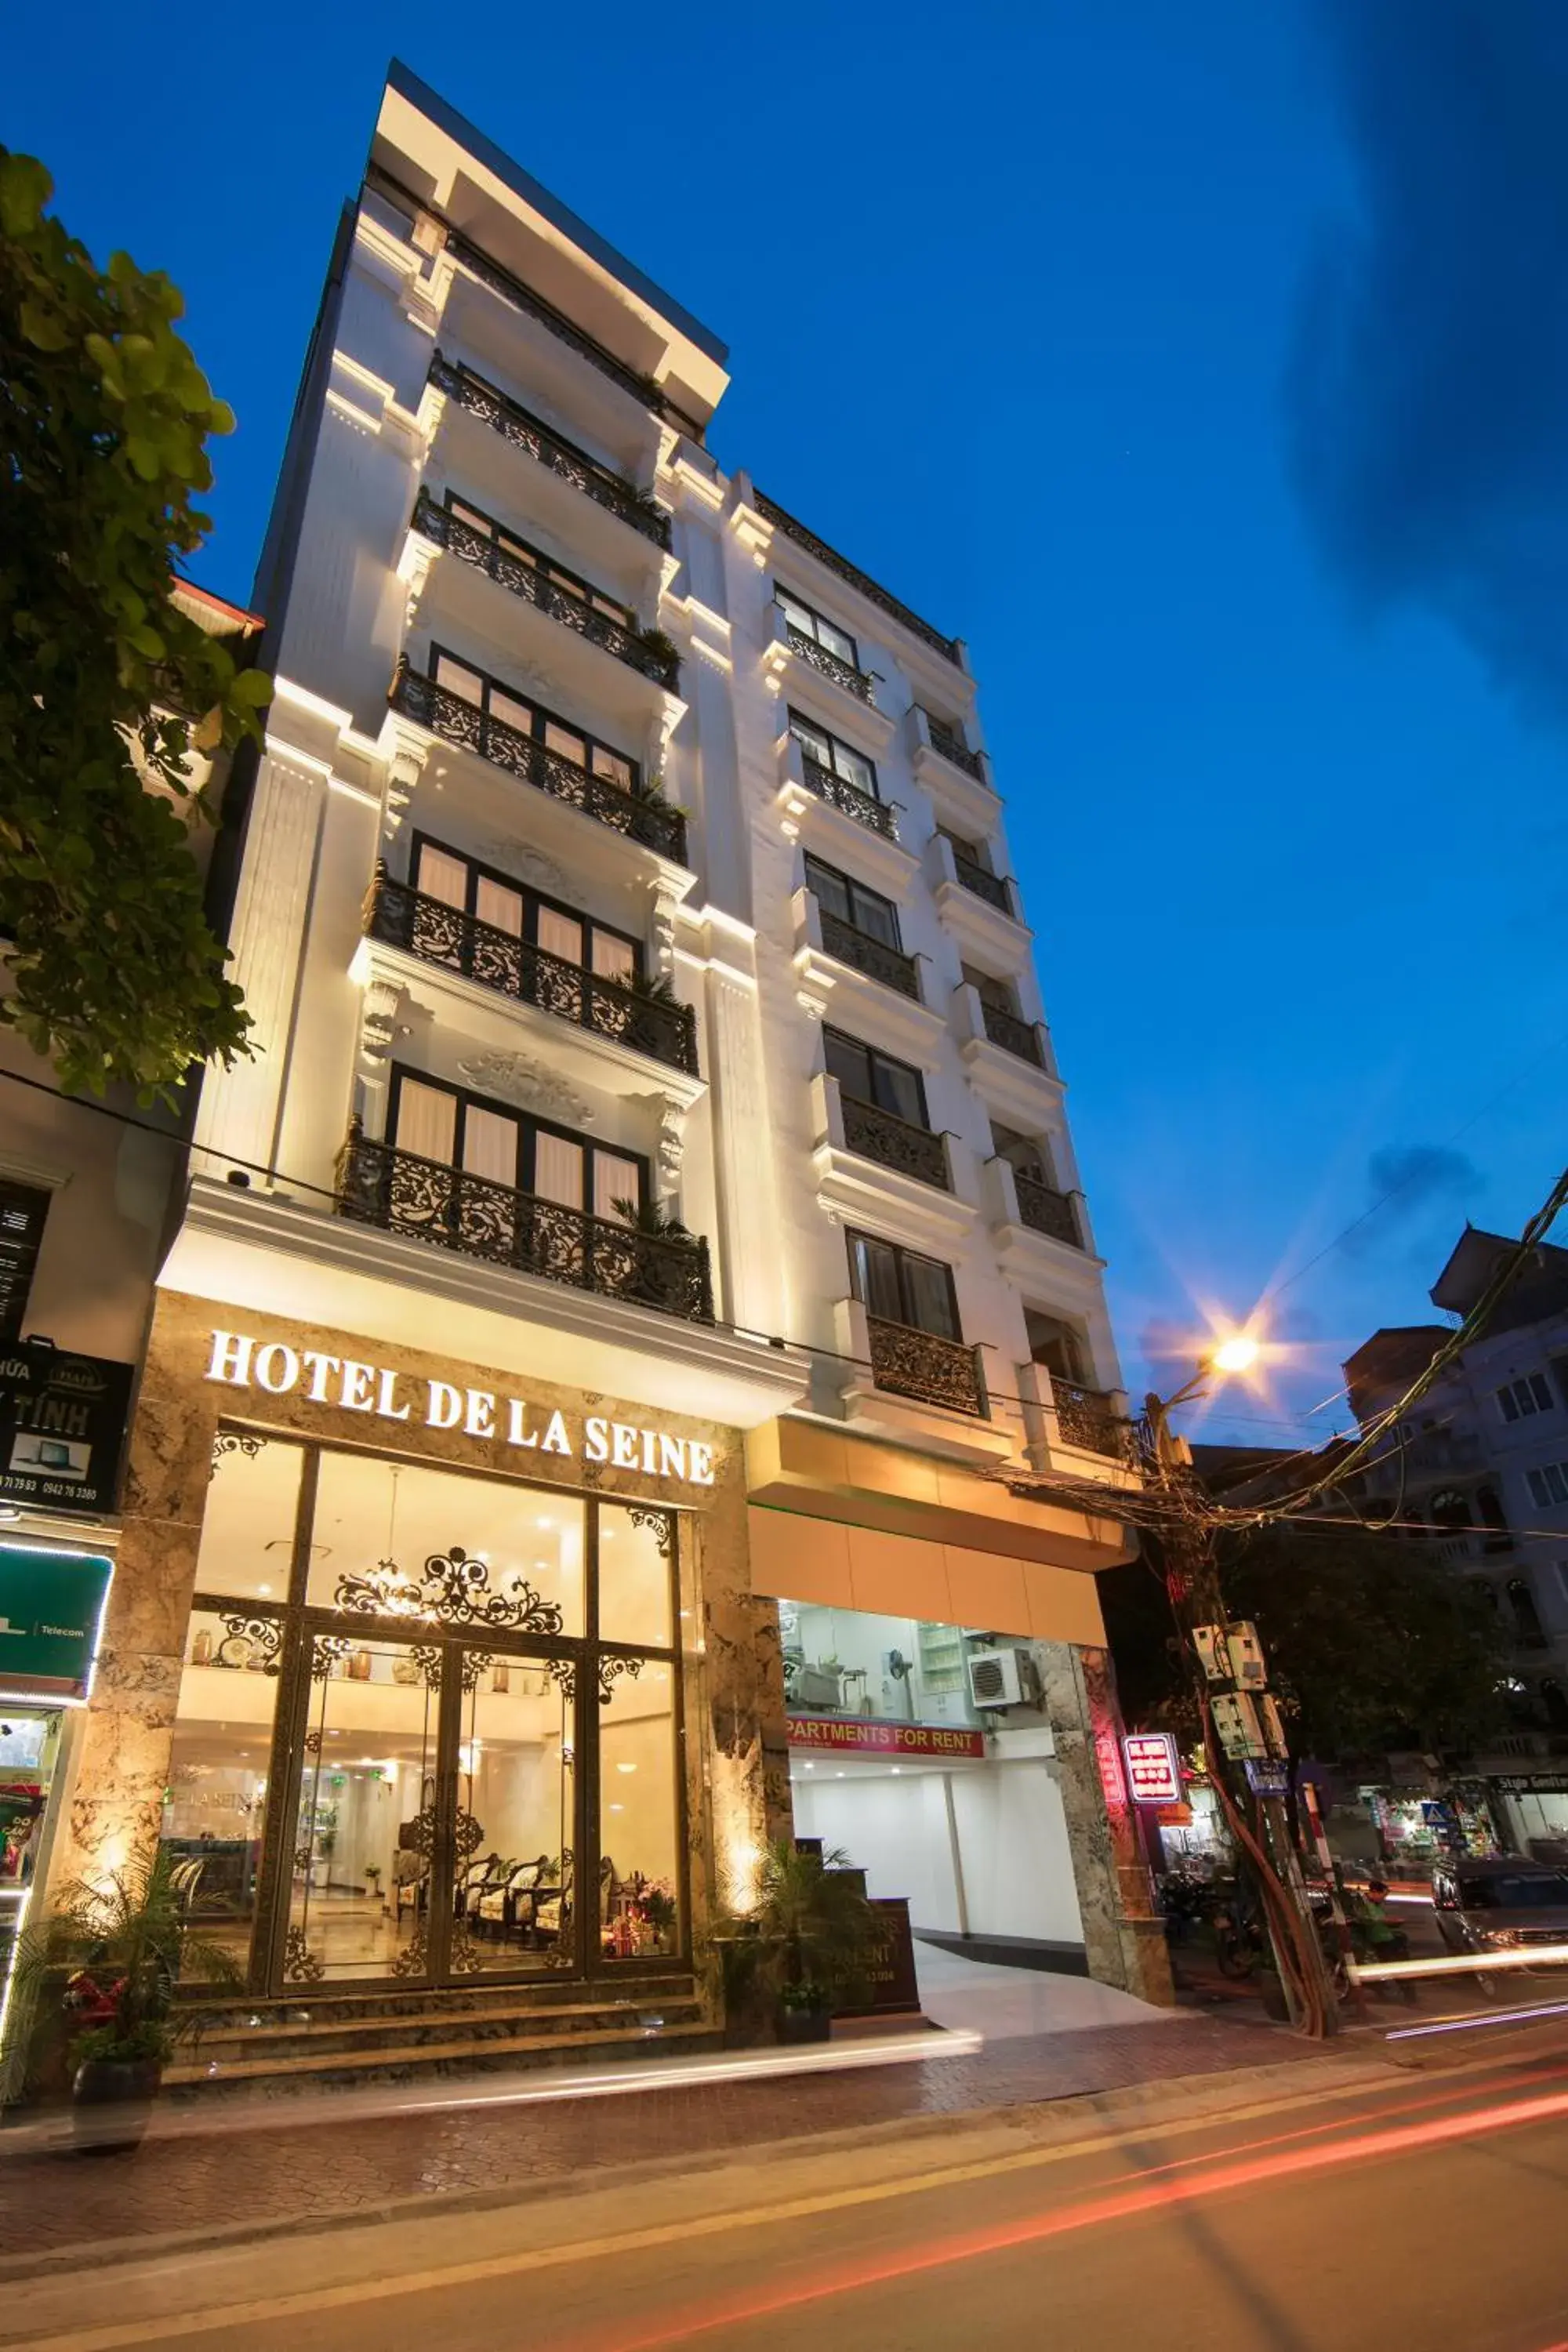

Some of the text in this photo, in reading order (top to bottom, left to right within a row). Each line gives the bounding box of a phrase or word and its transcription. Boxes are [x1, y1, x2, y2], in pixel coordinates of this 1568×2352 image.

[14, 1392, 90, 1436] TÍNH
[205, 1328, 714, 1486] HOTEL DE LA SEINE
[41, 1625, 84, 1638] Telecom
[895, 1729, 928, 1746] FOR
[932, 1733, 973, 1750] RENT
